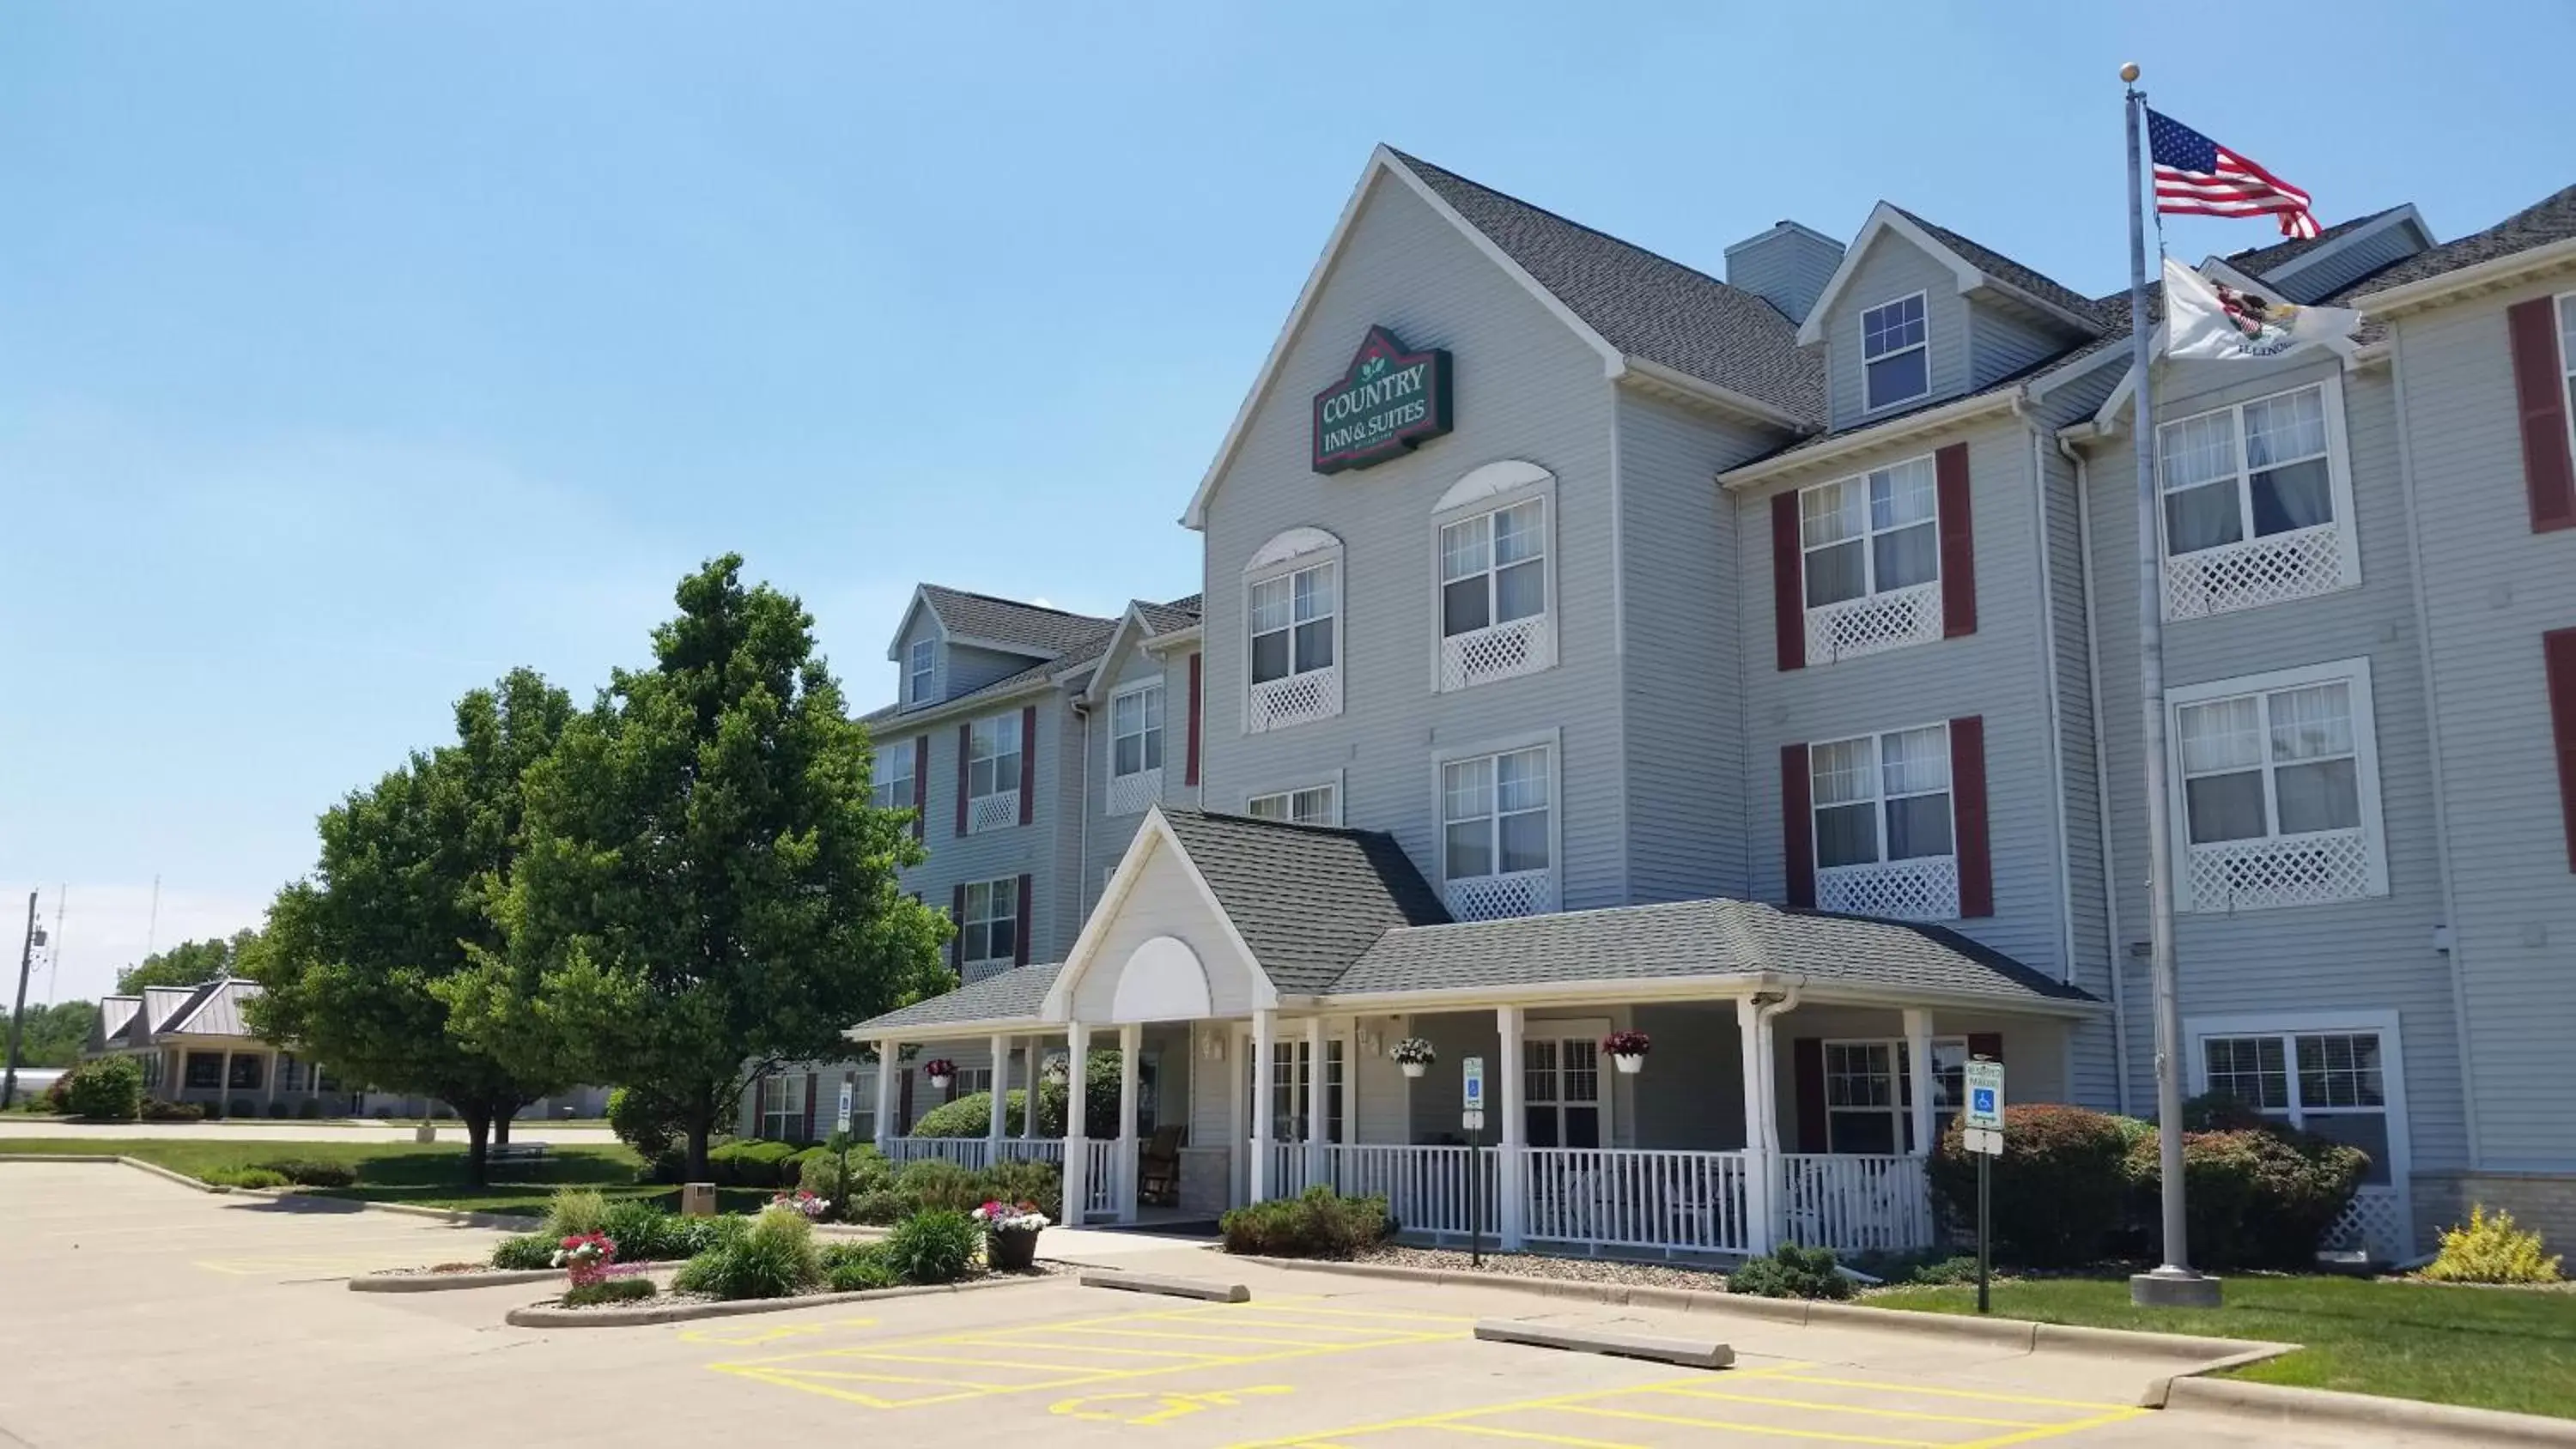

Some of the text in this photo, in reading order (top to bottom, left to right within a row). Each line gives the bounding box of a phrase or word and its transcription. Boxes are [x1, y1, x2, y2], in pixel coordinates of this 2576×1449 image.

[1323, 363, 1427, 423] COUNTRY
[1325, 426, 1352, 452] INN
[1353, 421, 1366, 440] &
[1368, 399, 1425, 435] SUITES
